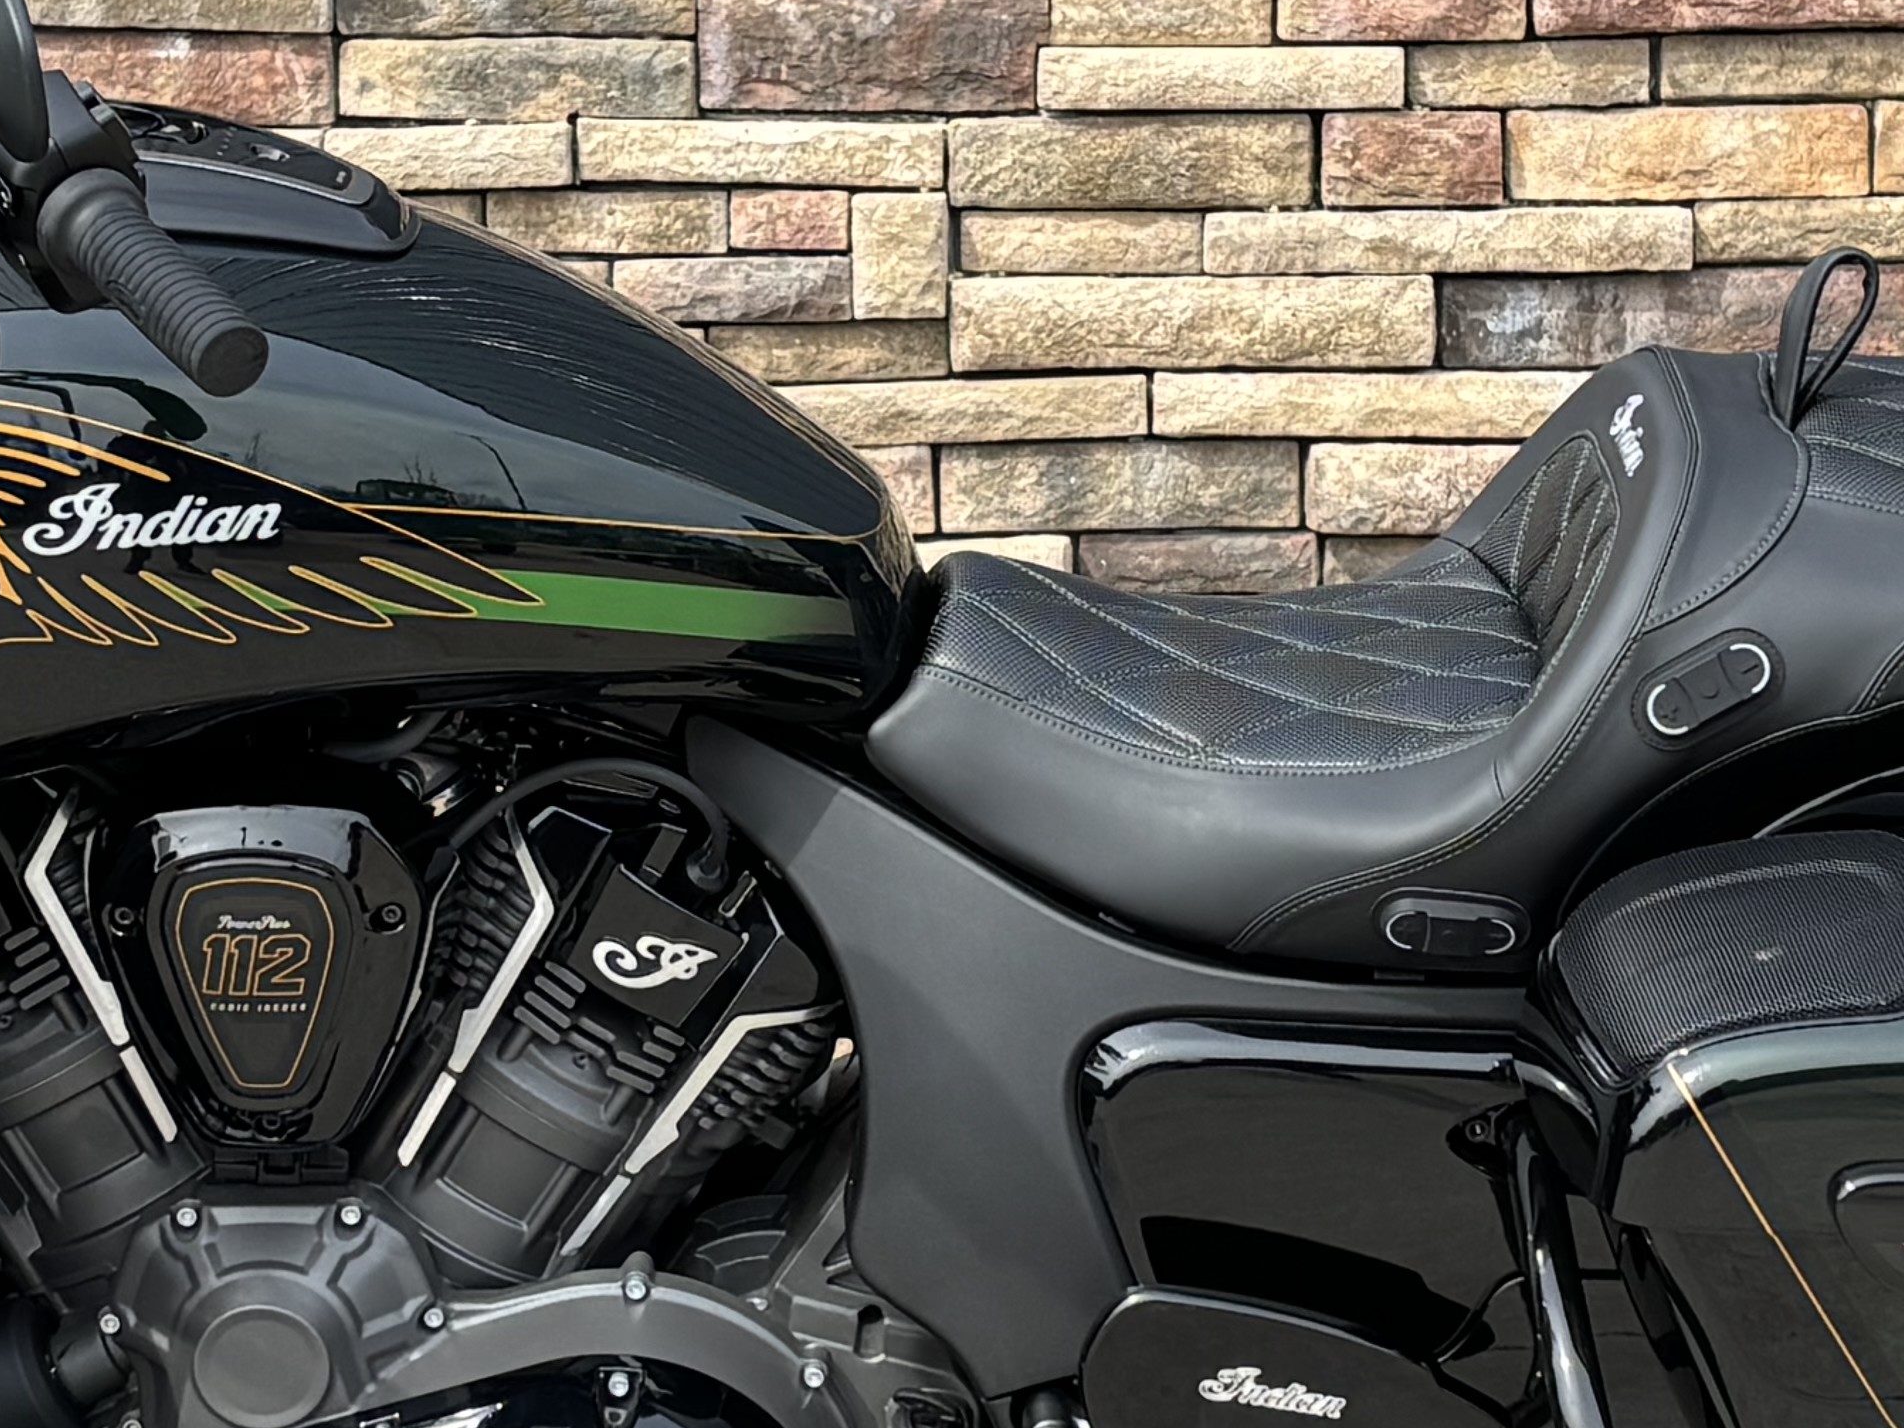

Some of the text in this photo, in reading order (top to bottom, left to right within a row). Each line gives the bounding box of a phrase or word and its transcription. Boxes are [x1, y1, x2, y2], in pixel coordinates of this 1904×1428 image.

[22, 482, 282, 557] Indian
[202, 933, 311, 996] 112
[1199, 1367, 1347, 1420] Indian
